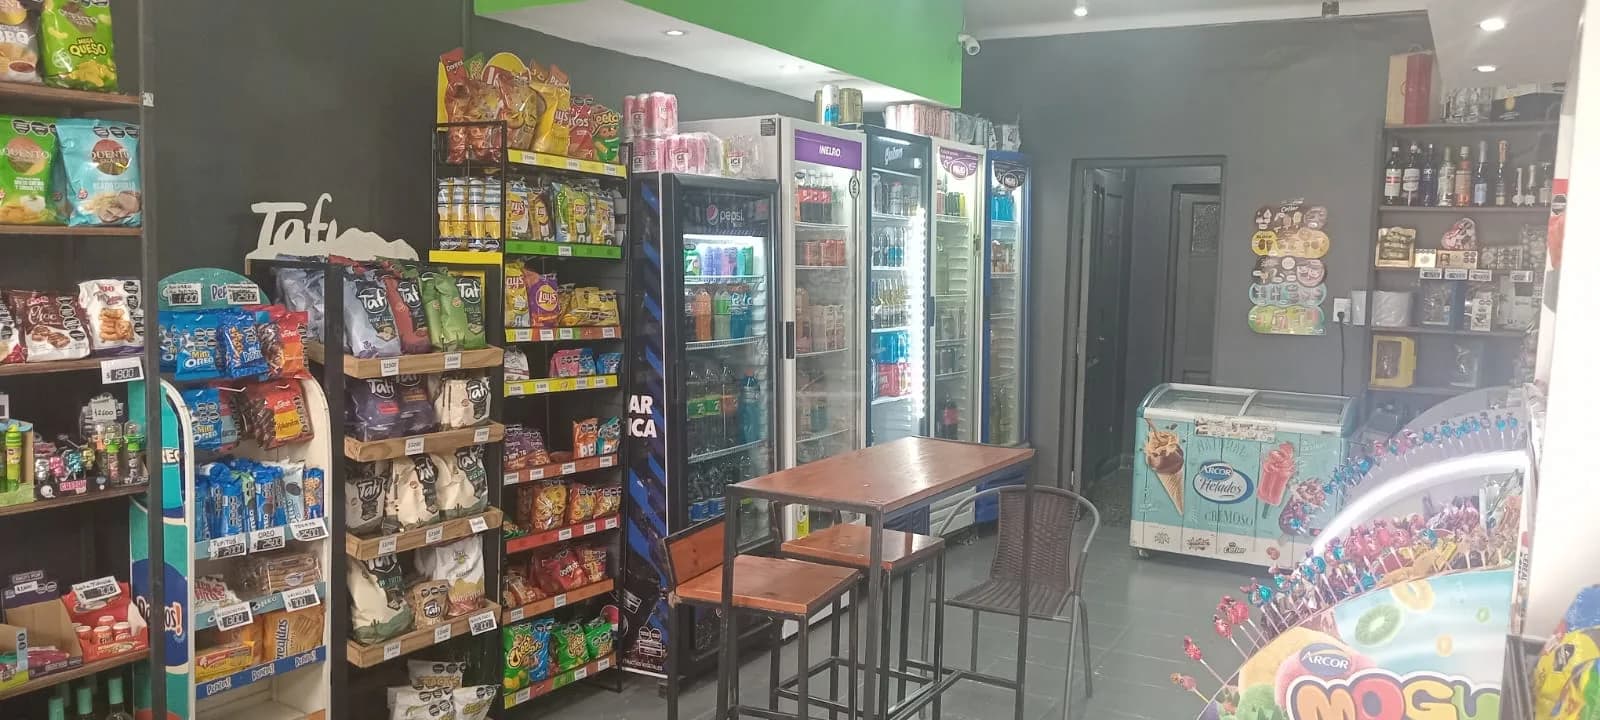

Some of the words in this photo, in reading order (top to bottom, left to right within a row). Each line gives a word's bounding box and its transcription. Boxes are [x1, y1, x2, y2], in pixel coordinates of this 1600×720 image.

[70, 44, 107, 56] QUESO
[819, 145, 841, 157] INELRO
[1203, 464, 1233, 477] ARCOR
[1201, 477, 1243, 495] Helados
[1302, 651, 1349, 670] ARCOR
